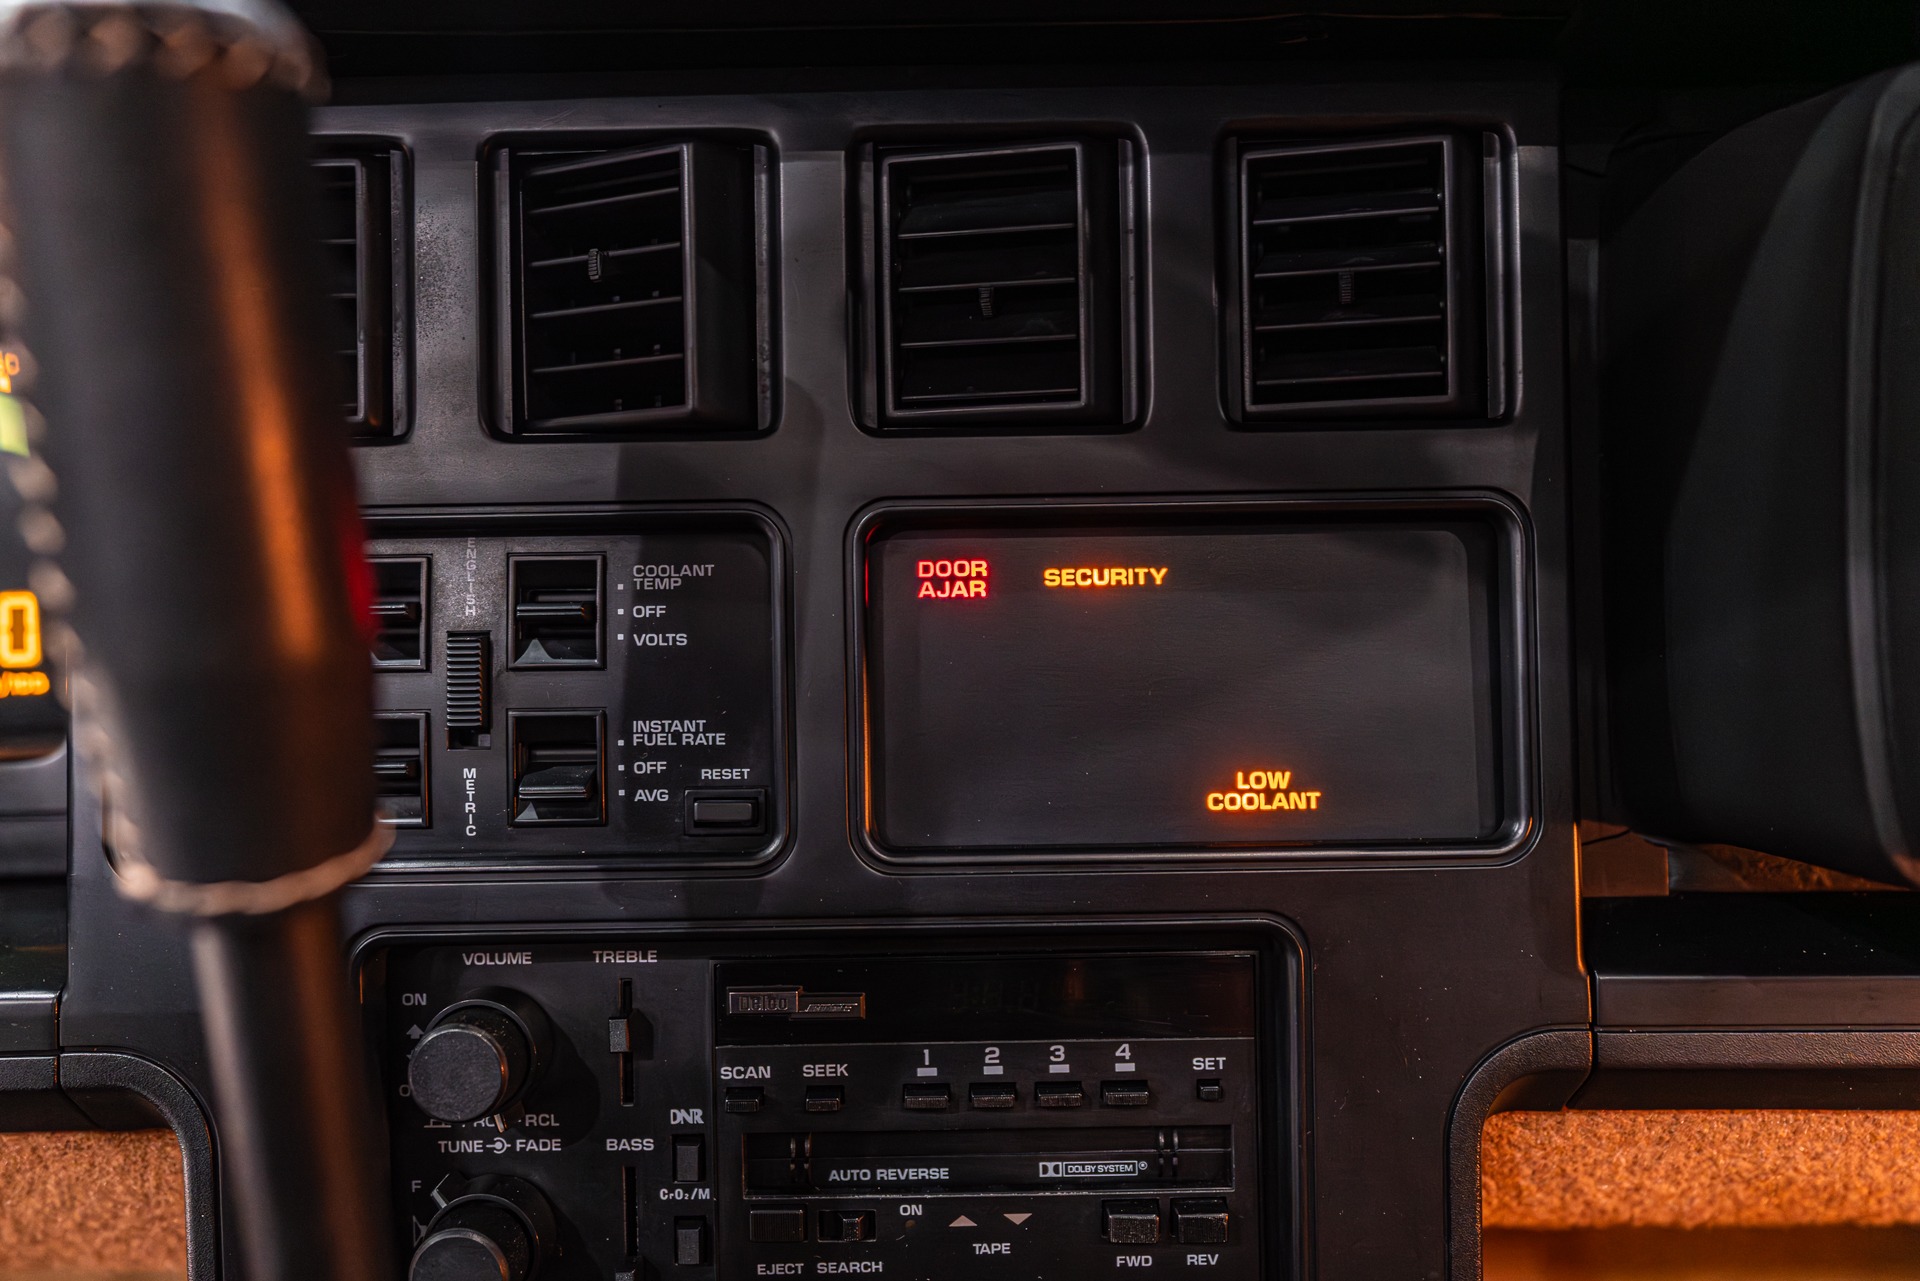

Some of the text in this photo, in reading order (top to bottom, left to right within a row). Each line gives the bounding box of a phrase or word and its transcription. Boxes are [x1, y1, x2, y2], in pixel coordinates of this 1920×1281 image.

[633, 565, 714, 577] COOLANT
[918, 560, 988, 578] DOOR
[465, 538, 477, 615] ENGLISH
[1044, 567, 1168, 586] SECURITY
[634, 578, 682, 590] TEMP
[919, 580, 987, 599] AJAR
[633, 606, 666, 618] OFF
[634, 634, 687, 646] VOLTS
[633, 720, 706, 732] INSTANT
[633, 734, 725, 746] FUEL RATE
[634, 762, 666, 774] OFF
[701, 769, 750, 779] RESET
[1237, 771, 1290, 790] LOW
[463, 768, 476, 836] METRIC
[634, 789, 669, 802] AVG
[1207, 792, 1321, 811] COOLANT
[463, 952, 532, 965] VOLUME
[593, 950, 657, 963] TREBLE
[402, 993, 427, 1006] ON
[923, 1049, 930, 1066] 1
[985, 1047, 1000, 1063] 2
[1050, 1045, 1065, 1061] 3
[1115, 1044, 1130, 1060] 4
[803, 1063, 848, 1078] SEEK
[1192, 1056, 1226, 1071] SET
[721, 1065, 770, 1079] SCAN
[670, 1109, 704, 1125] DNR
[439, 1139, 562, 1153] TUNE FADE
[606, 1139, 654, 1151] BASS
[829, 1168, 949, 1181] AUTO REVERSE
[1068, 1163, 1134, 1174] DOLBY SYSTEM
[411, 1181, 421, 1192] F
[900, 1204, 922, 1216] ON
[973, 1242, 1010, 1255] TAPE
[1116, 1254, 1152, 1268] FWD
[1187, 1252, 1219, 1266] REV
[757, 1261, 883, 1275] EJECT SEARCH
